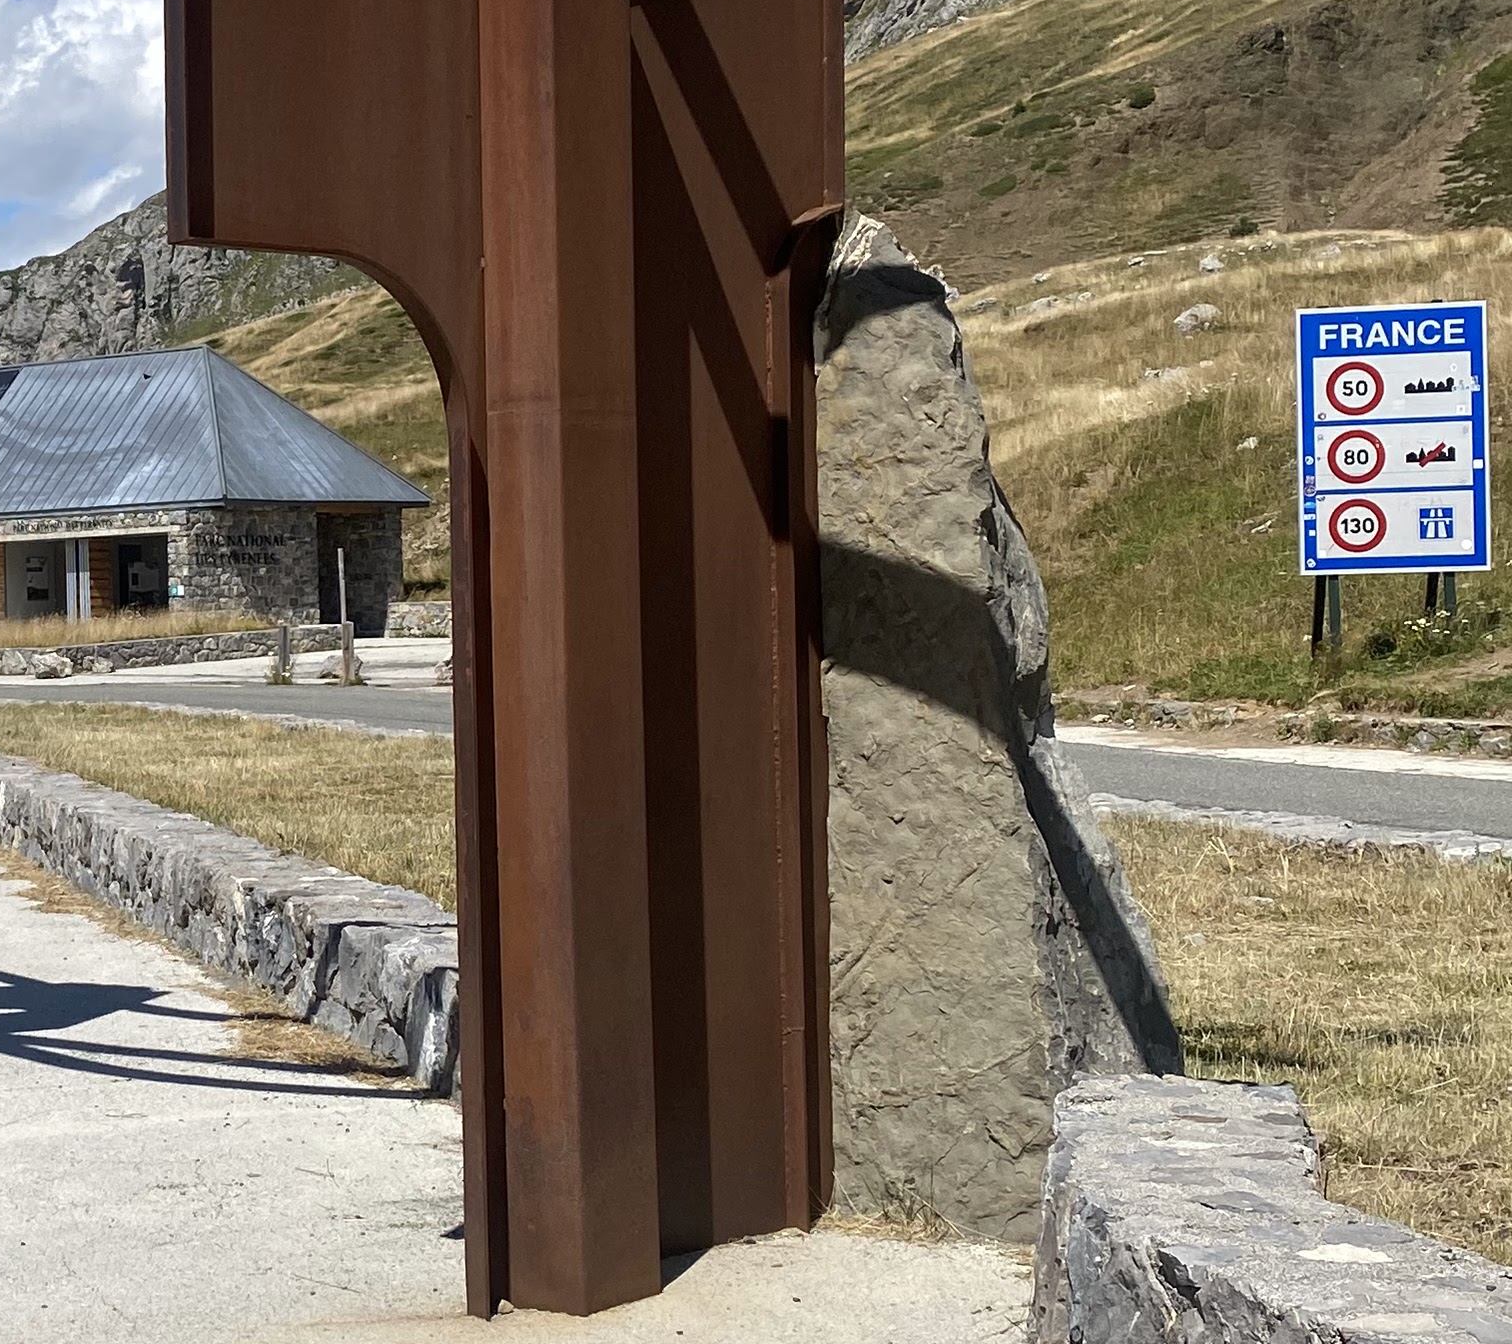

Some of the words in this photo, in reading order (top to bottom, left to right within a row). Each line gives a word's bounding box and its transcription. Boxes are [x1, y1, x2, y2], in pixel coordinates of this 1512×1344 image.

[1319, 318, 1466, 350] FRANCE
[1342, 380, 1368, 397] 50
[1343, 449, 1369, 466] 80
[1340, 517, 1375, 534] 130
[227, 534, 286, 547] NATIONAL
